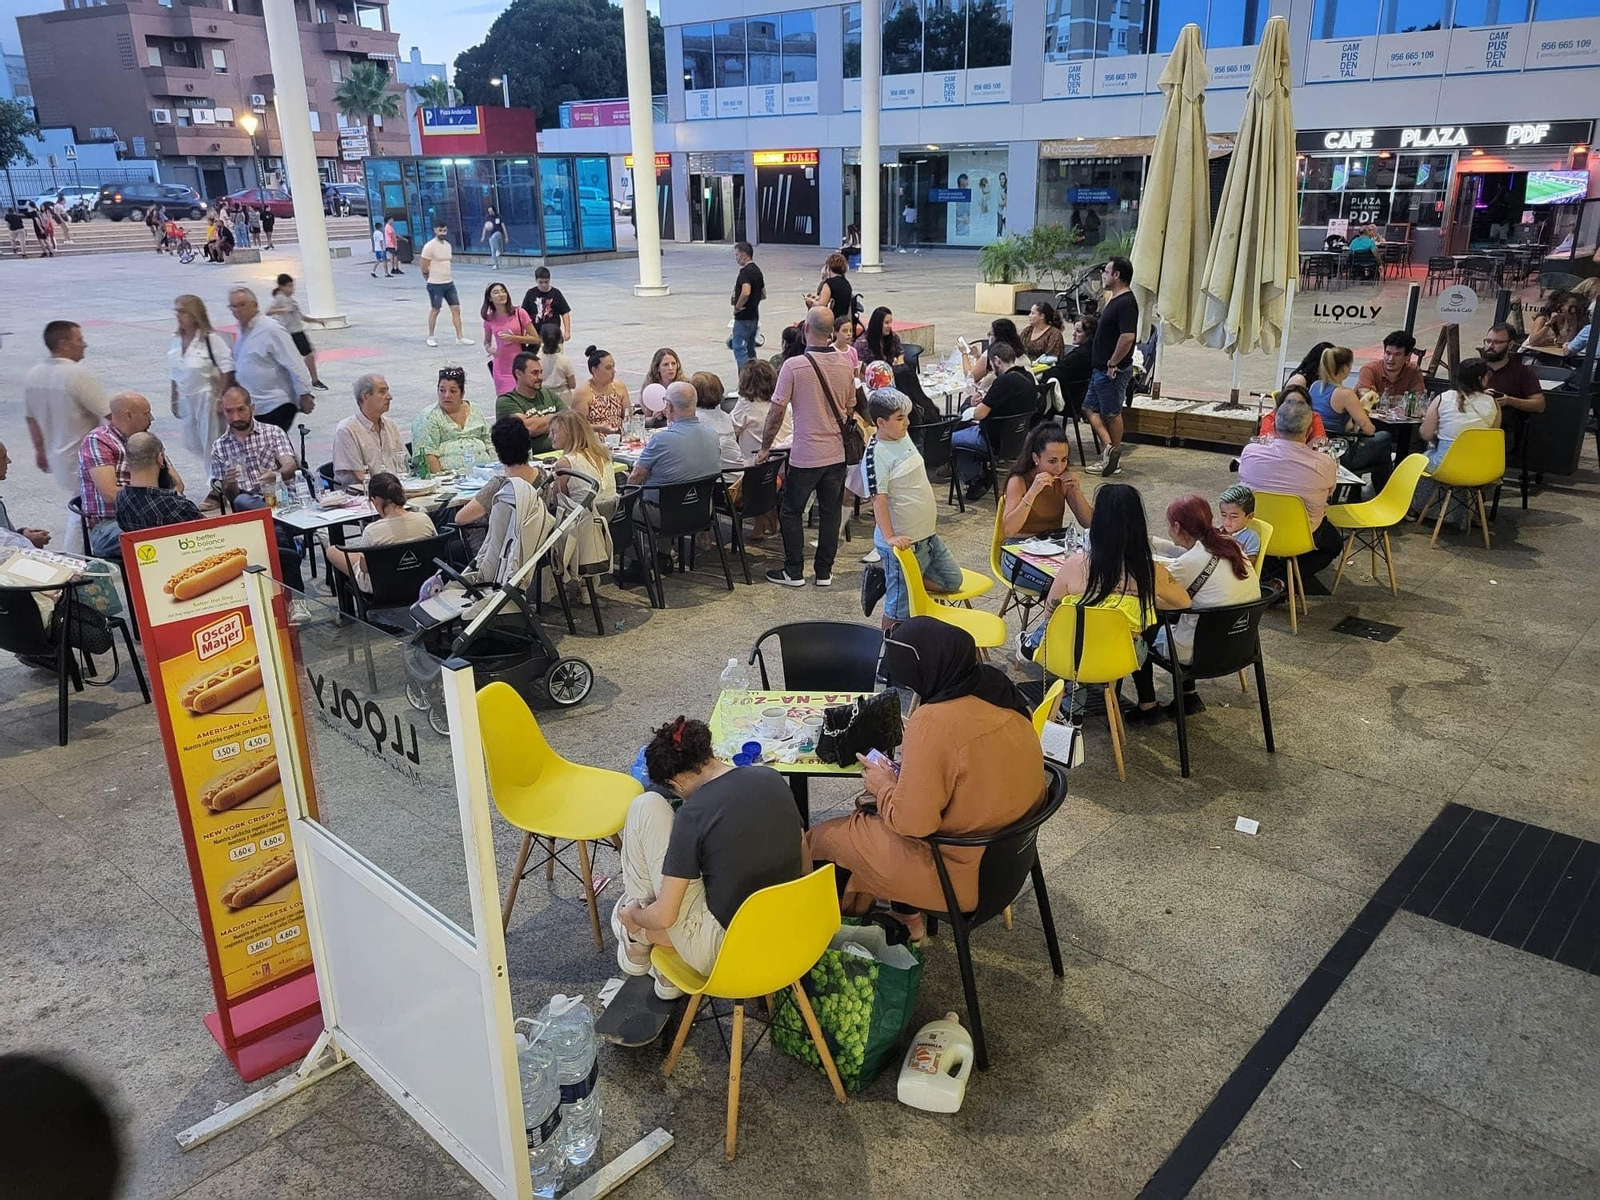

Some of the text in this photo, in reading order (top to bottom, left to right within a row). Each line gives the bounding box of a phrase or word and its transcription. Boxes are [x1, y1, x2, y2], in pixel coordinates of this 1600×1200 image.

[1489, 32, 1509, 41] CAM
[1342, 44, 1359, 52] CAM
[1487, 41, 1507, 51] PUS
[1541, 39, 1591, 50] 956 665 109
[1341, 52, 1358, 61] PUS
[1391, 51, 1434, 61] 956 665 109
[1486, 51, 1506, 60] DEN
[1486, 60, 1504, 68] TAL
[425, 111, 433, 124] P
[1324, 124, 1551, 149] CAFE PLAZA PDF
[1349, 211, 1380, 223] PDF
[197, 538, 225, 547] balance
[202, 620, 236, 643] Oscar
[201, 628, 240, 654] Mayer
[197, 722, 240, 739] AMERICAN
[183, 744, 201, 752] Nuestra
[202, 736, 222, 746] salchicha
[223, 731, 241, 740] especial
[250, 724, 267, 733] ketchup
[203, 829, 222, 840] NEW
[224, 821, 246, 833] YORK
[248, 812, 275, 824] CRISPY
[251, 822, 269, 833] especial
[220, 900, 304, 936] MADISON CHEESE LOV
